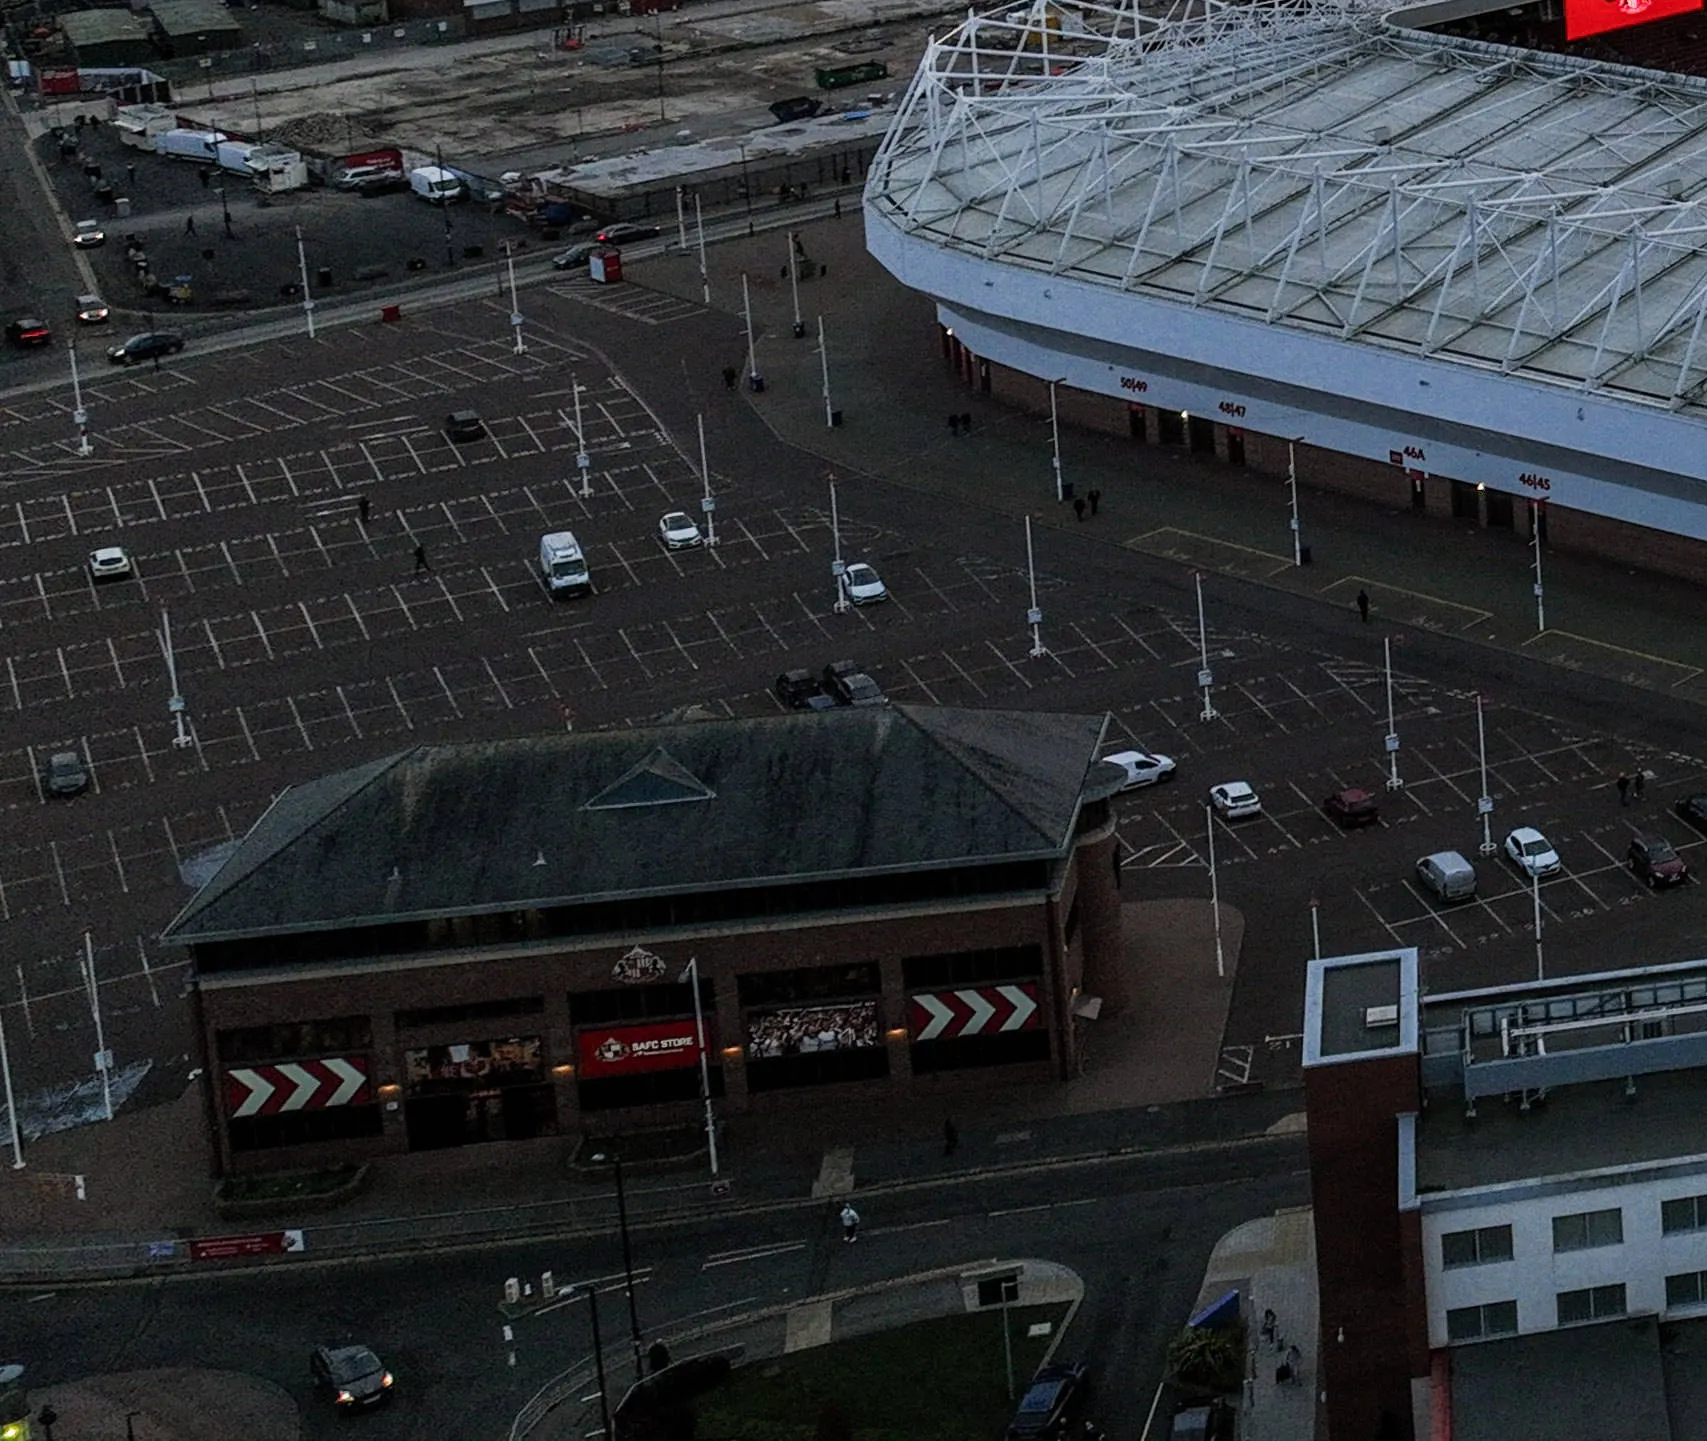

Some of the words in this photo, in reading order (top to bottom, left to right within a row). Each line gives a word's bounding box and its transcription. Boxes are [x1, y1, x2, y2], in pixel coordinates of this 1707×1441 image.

[1403, 446, 1426, 461] 46A
[632, 1041, 660, 1052] SAFC
[660, 1036, 693, 1048] STORE
